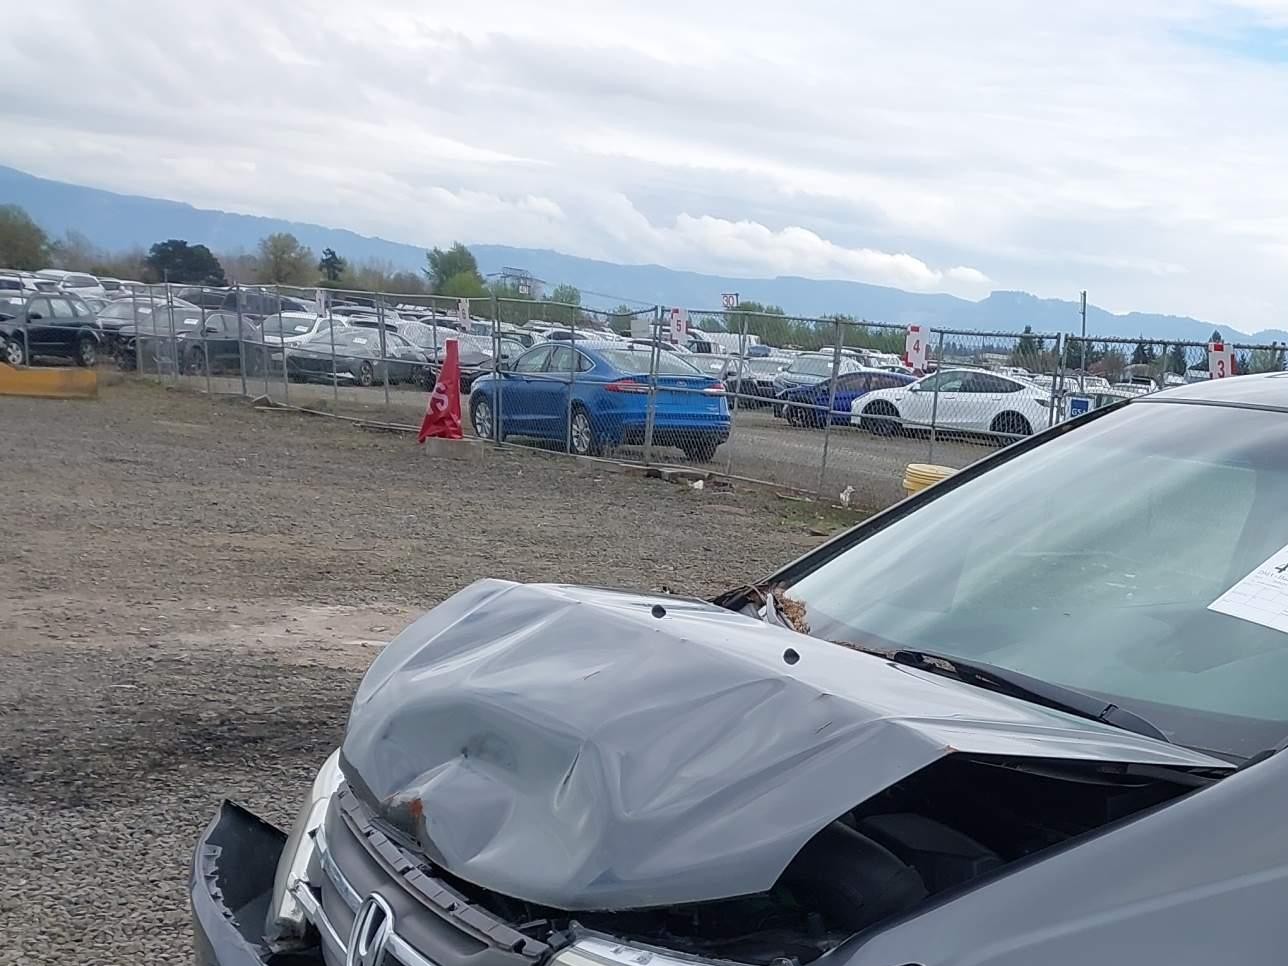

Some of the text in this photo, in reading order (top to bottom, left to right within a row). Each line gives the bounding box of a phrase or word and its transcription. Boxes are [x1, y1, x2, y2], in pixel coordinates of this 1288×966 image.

[722, 294, 735, 307] 30
[676, 319, 682, 332] 5
[913, 340, 920, 353] 4
[1217, 360, 1225, 378] 3
